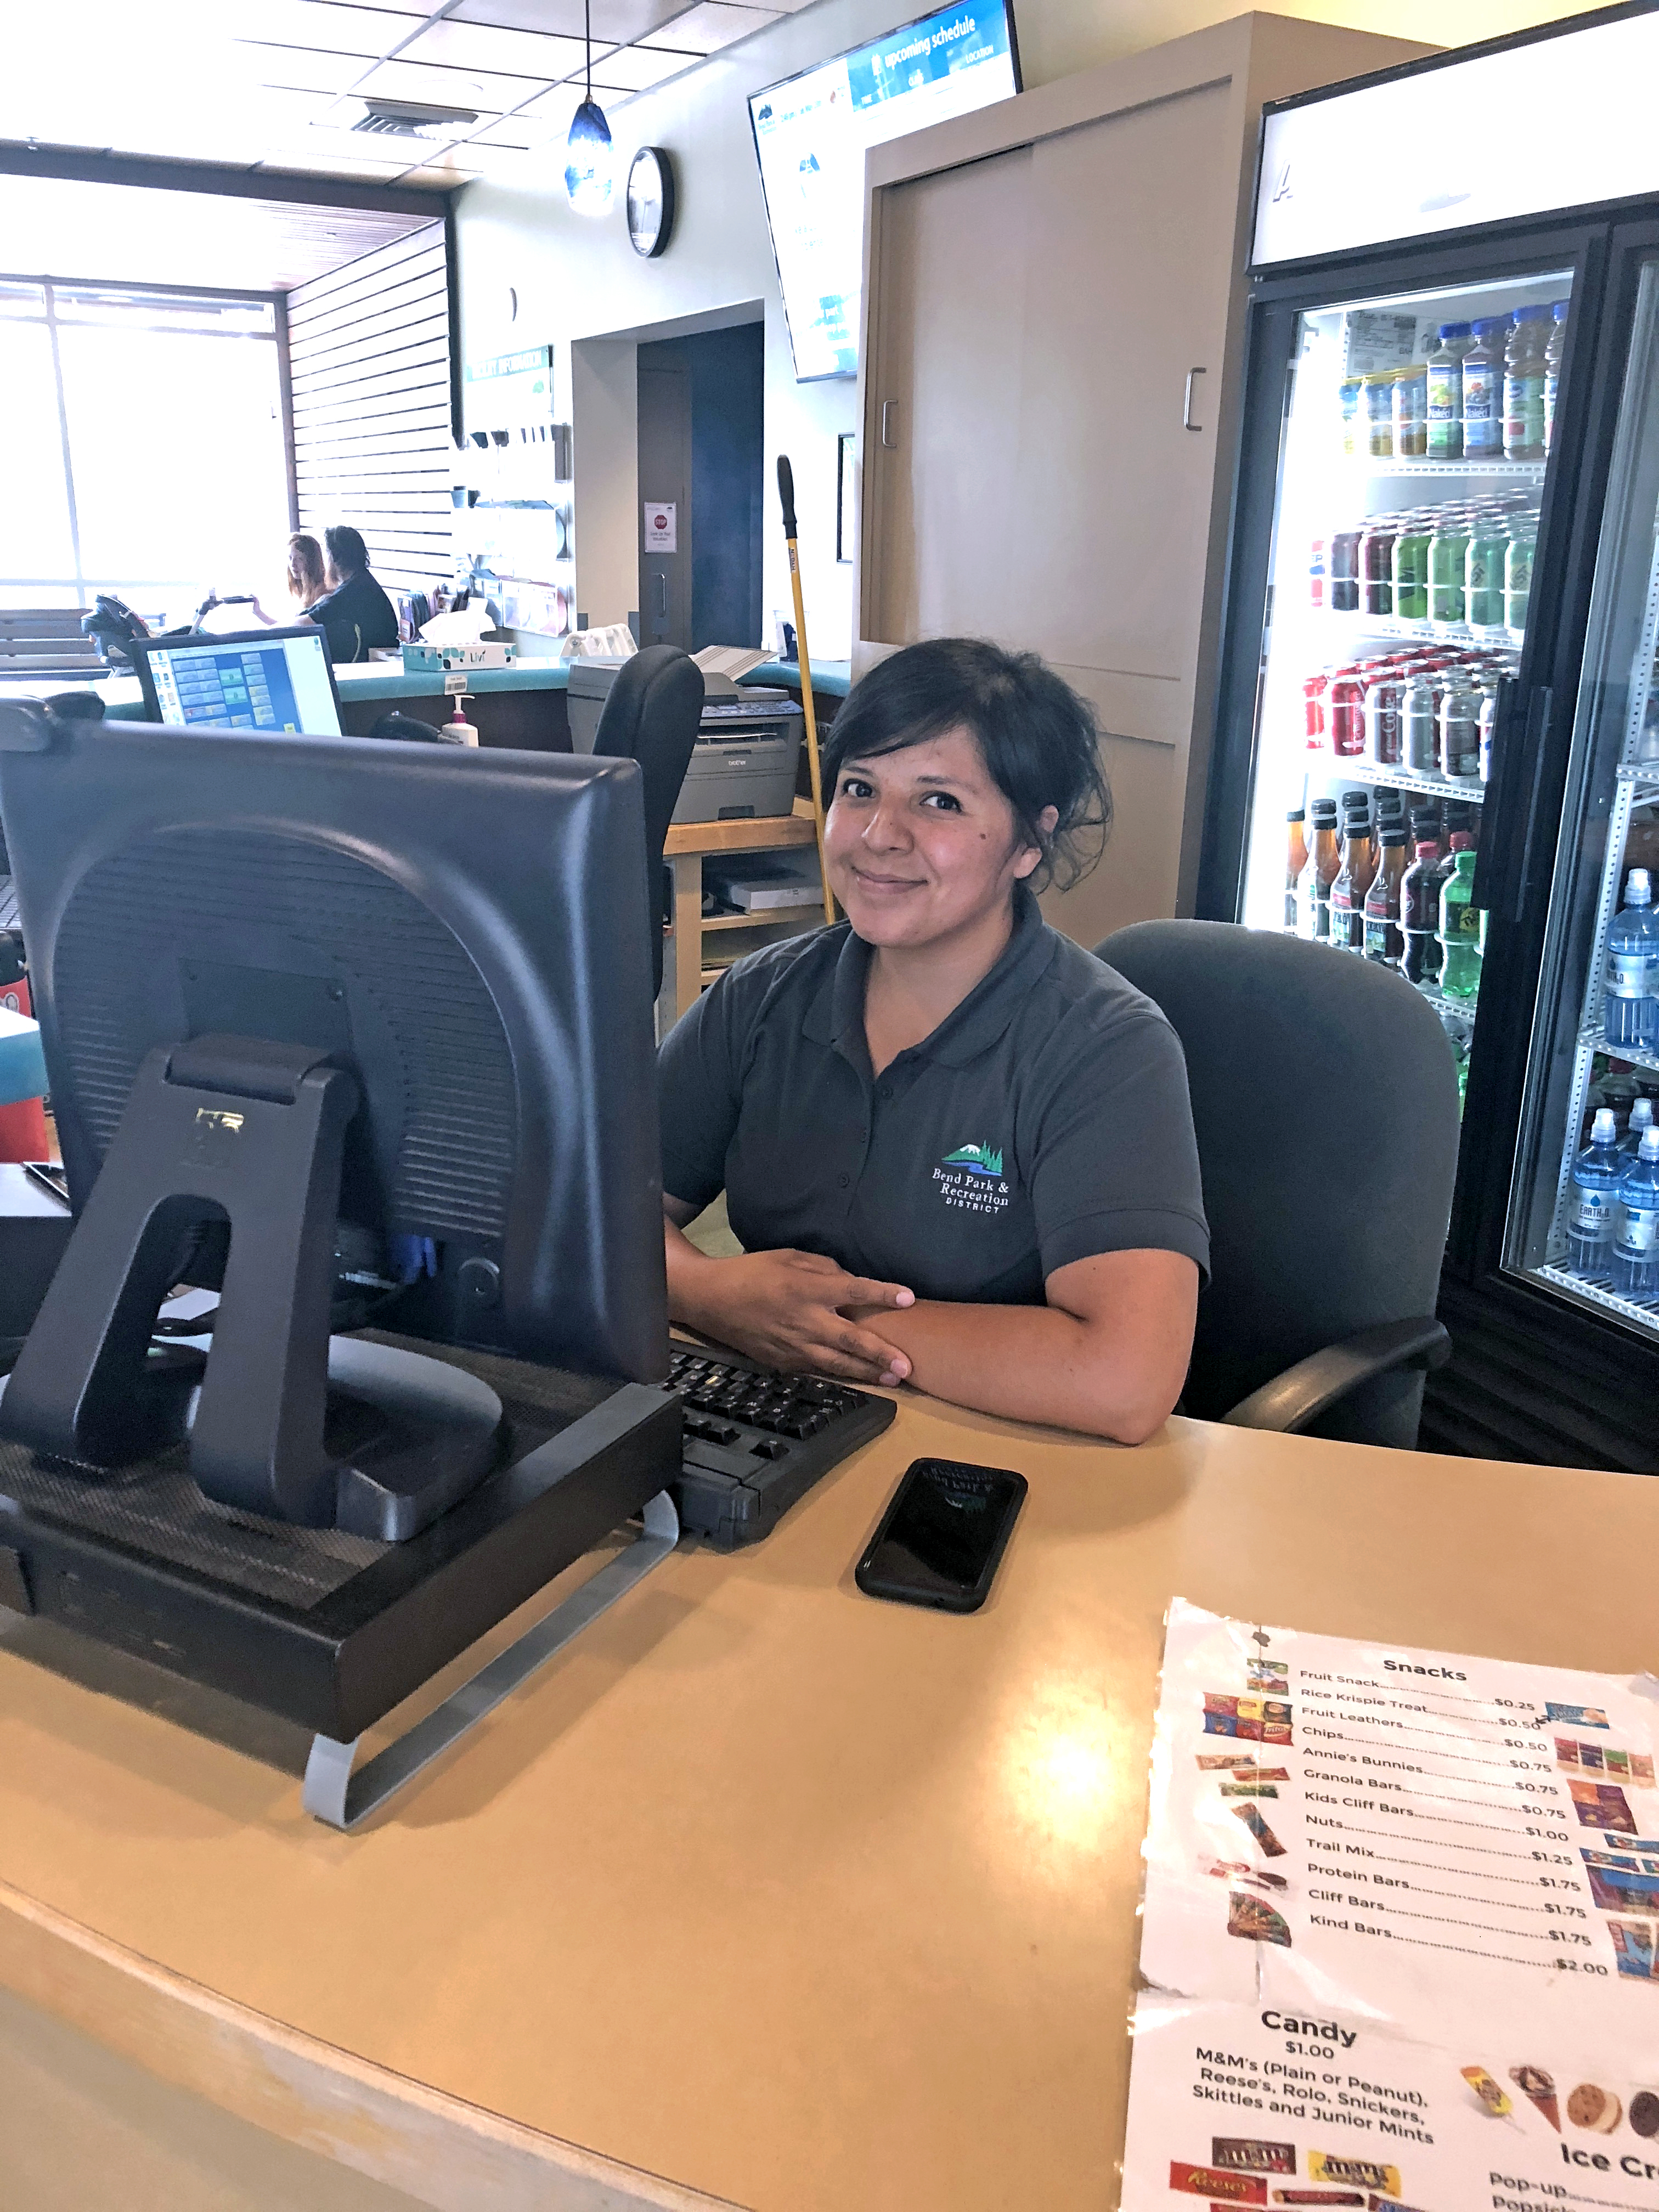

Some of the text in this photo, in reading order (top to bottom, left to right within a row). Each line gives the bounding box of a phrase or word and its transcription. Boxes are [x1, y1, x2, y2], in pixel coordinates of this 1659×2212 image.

[884, 15, 975, 70] upcoming schedule
[965, 44, 994, 64] LOCATION
[932, 1168, 1009, 1193] Bend Park &
[939, 1182, 1008, 1206] Recreation
[945, 1197, 999, 1214] DISTRICT
[1300, 1670, 1535, 1711] Fruit Snack $0.25
[1384, 1660, 1467, 1681] Snacks
[1301, 1689, 1542, 1730] Rice Krispie Treat $0.50
[1302, 1706, 1548, 1752] Fruit Leathers $0.50
[1302, 1726, 1552, 1773] Chips $0.75
[1303, 1747, 1558, 1796] Annie's Bunnies $0.75
[1304, 1769, 1566, 1819] Granola Bars $0.75
[1305, 1791, 1569, 1842] Kids Cliff Bars $1.00
[1305, 1814, 1573, 1866] Nuts $1.25
[1306, 1837, 1581, 1892] Trail Mix $1.75
[1307, 1863, 1587, 1919] Protein Bars $1.75
[1308, 1889, 1592, 1946] Cliff Bars $1.75
[1310, 1914, 1609, 1976] Kind Bars $2.00
[1261, 2010, 1358, 2049] Candy
[1285, 2040, 1334, 2059] $1.00
[1196, 2046, 1428, 2108] M&M's (Plain or Peanut),
[1200, 2067, 1425, 2125] Reese's, Rolo, Snickers,
[1192, 2084, 1435, 2146] Skittles and Junior Mints
[1560, 2141, 1659, 2180] Ice Cr
[1489, 2171, 1567, 2198] Pop-up
